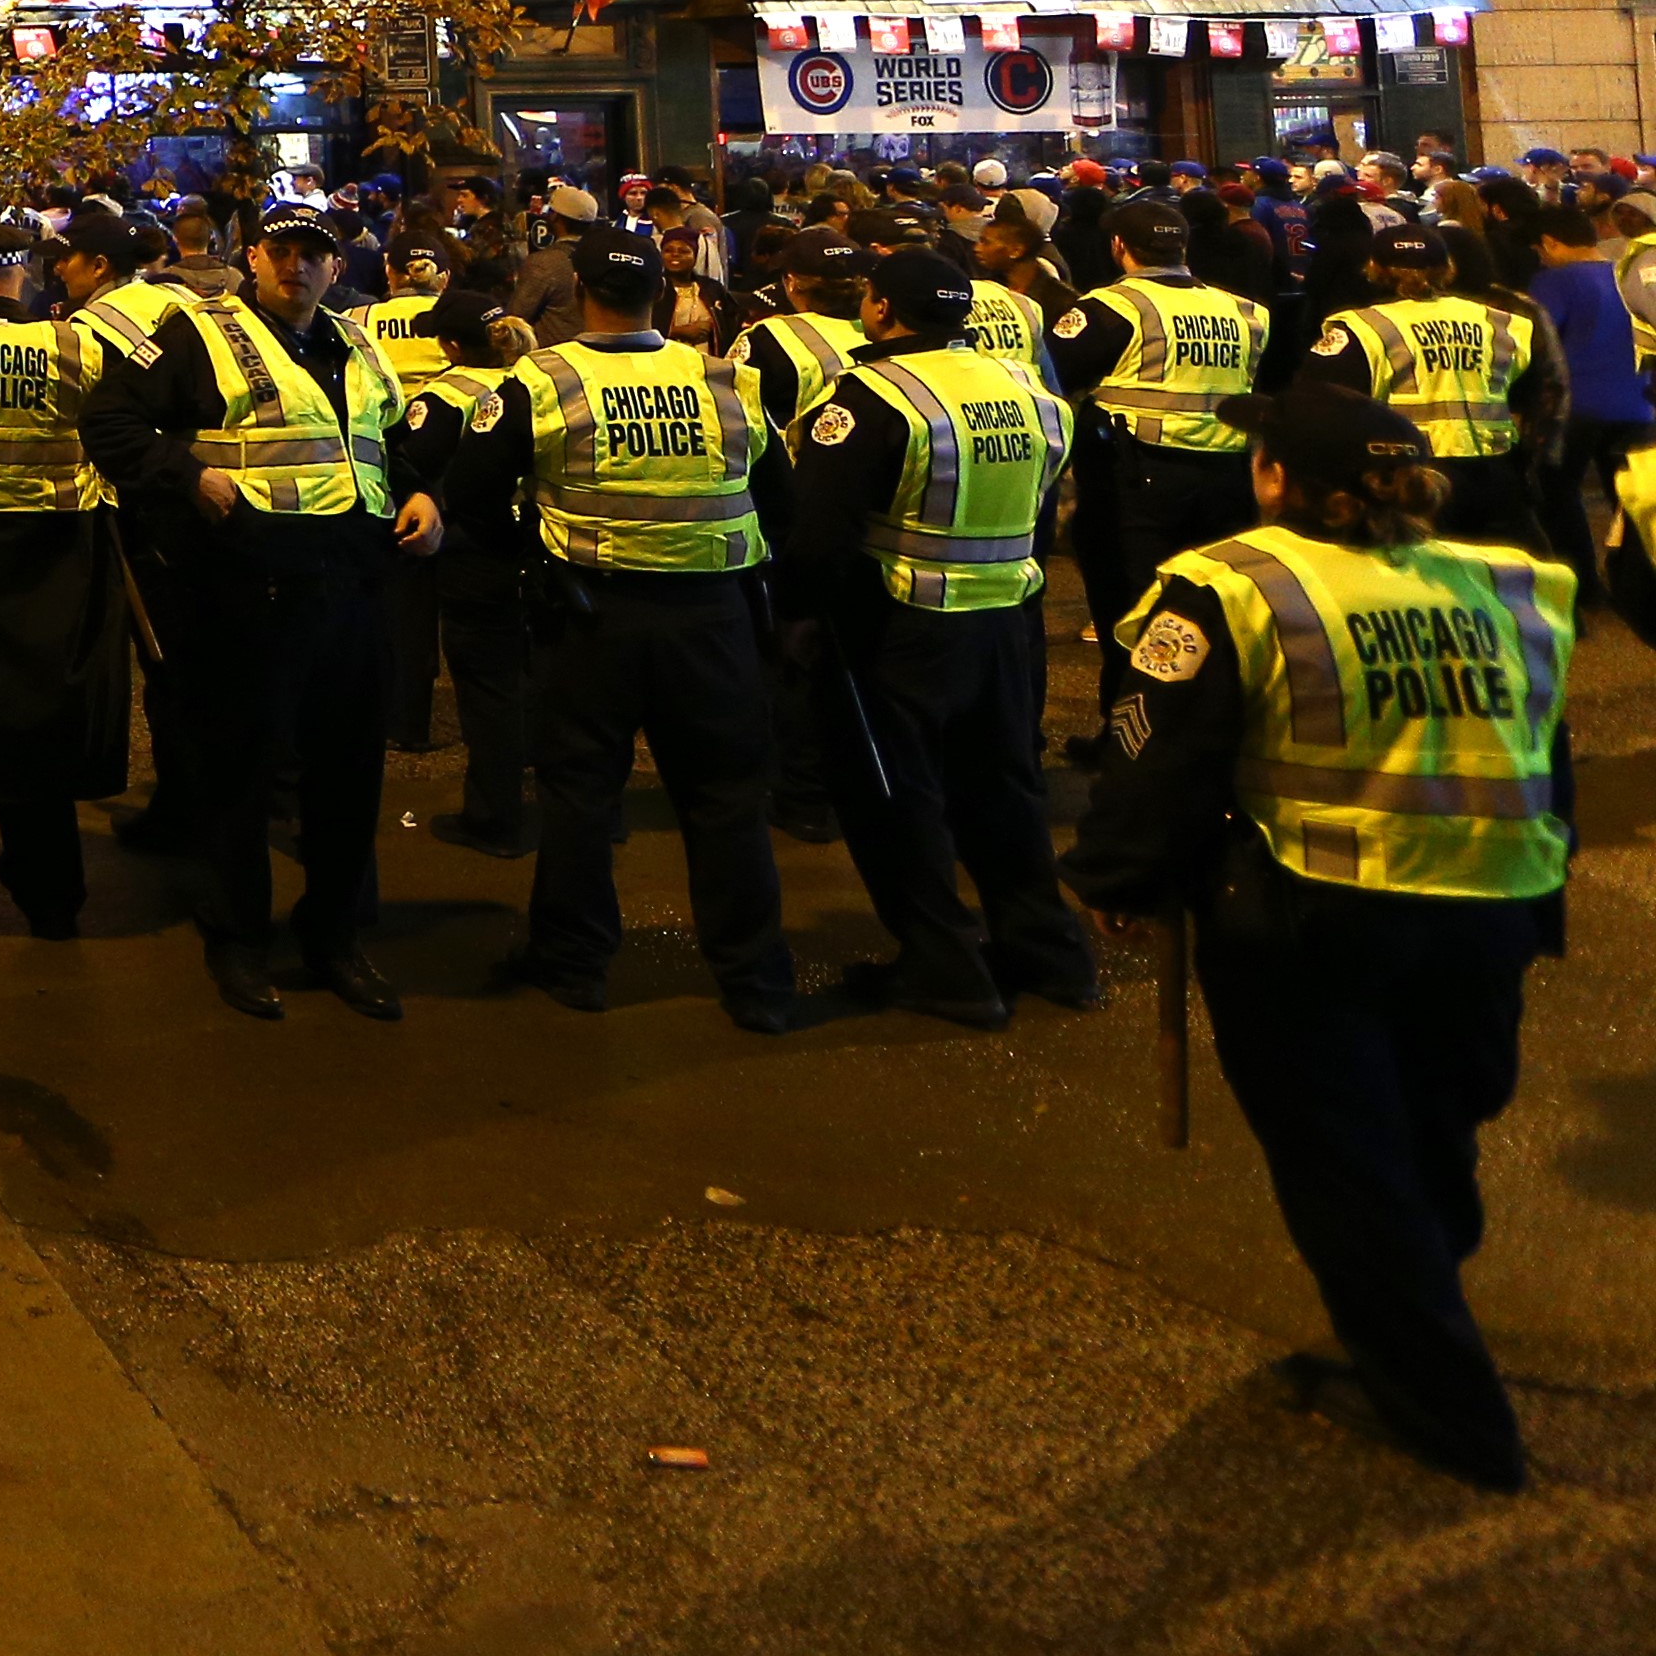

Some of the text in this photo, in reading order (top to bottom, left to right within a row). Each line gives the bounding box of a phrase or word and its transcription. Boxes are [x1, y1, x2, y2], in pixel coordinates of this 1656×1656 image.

[874, 57, 962, 79] WORLD
[998, 52, 1036, 106] C
[876, 81, 963, 106] SERIES
[910, 116, 935, 128] FOX
[537, 225, 547, 244] P
[1154, 225, 1182, 234] CPD
[410, 248, 435, 257] CPD
[824, 246, 853, 256] CPD
[1394, 241, 1426, 250] CPD
[608, 252, 645, 266] CPD
[936, 289, 969, 301] CPD
[377, 319, 415, 340] POLI
[1173, 314, 1239, 341] CHICAGO
[1410, 320, 1483, 347] CHICAGO
[223, 322, 278, 403] CHICAGO
[1176, 341, 1240, 369] POLICE
[602, 385, 700, 420] CHICAGO
[961, 400, 1025, 431] CHICAGO
[608, 422, 707, 457] POLICE
[973, 432, 1031, 464] POLICE
[1369, 443, 1419, 455] CPD
[1346, 607, 1497, 667] CHICAGO
[1367, 665, 1514, 721] POLICE
